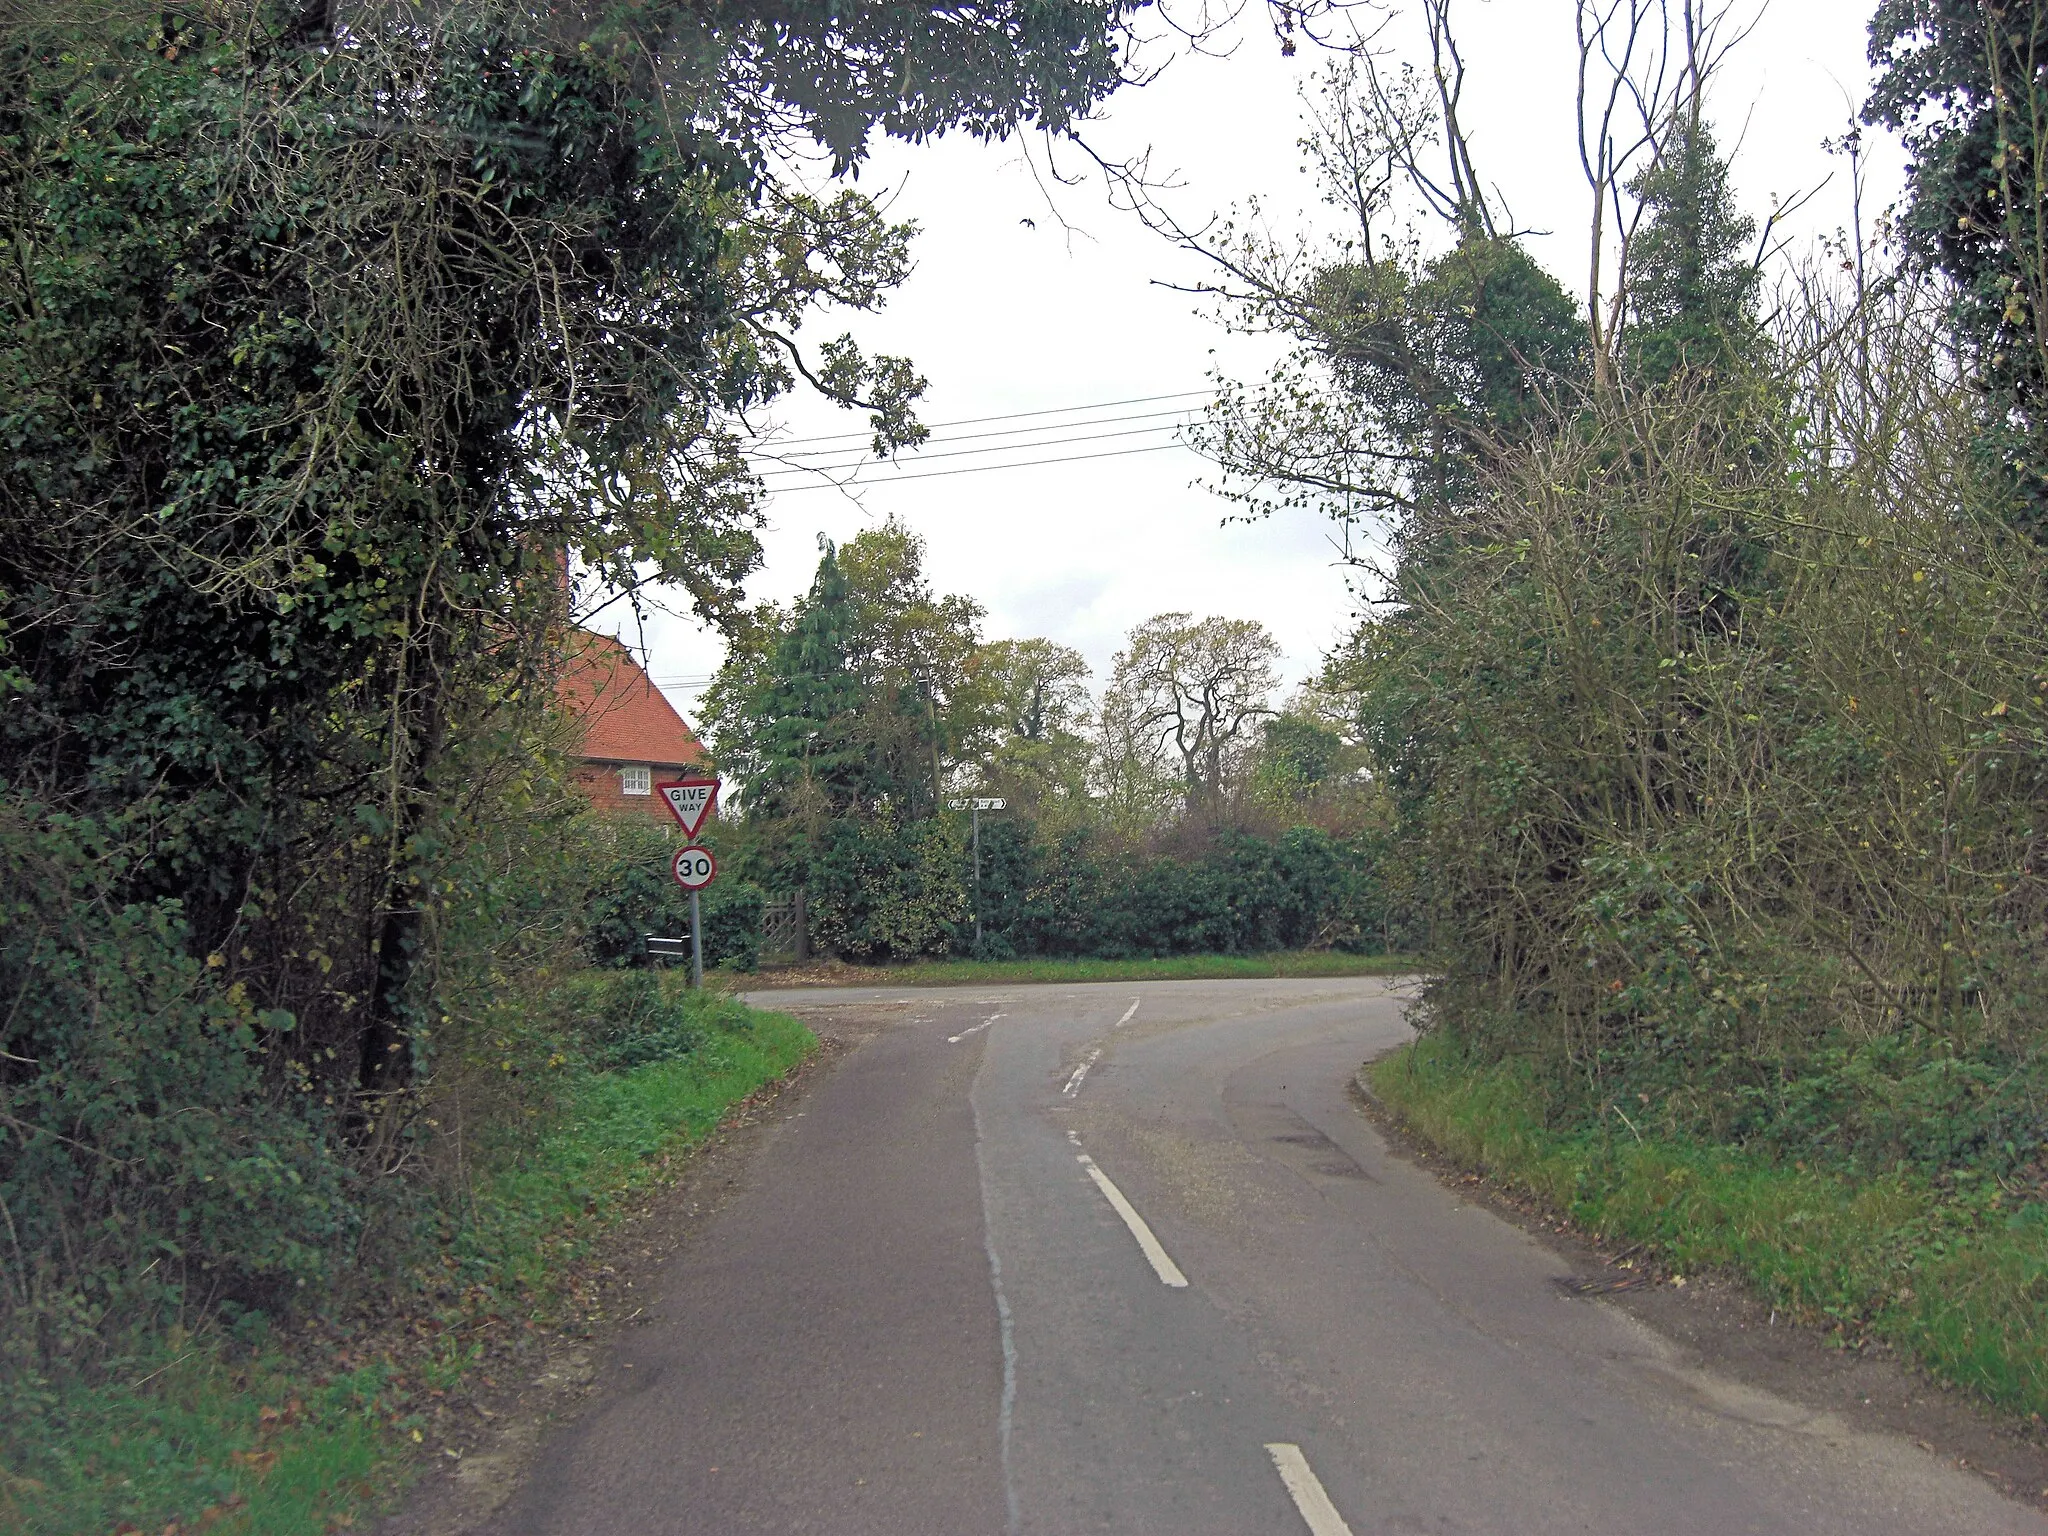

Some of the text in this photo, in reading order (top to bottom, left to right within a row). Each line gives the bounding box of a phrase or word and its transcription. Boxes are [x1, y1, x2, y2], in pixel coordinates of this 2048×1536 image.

[670, 788, 707, 801] GIVE
[679, 803, 702, 812] WAY
[678, 858, 710, 877] 30
